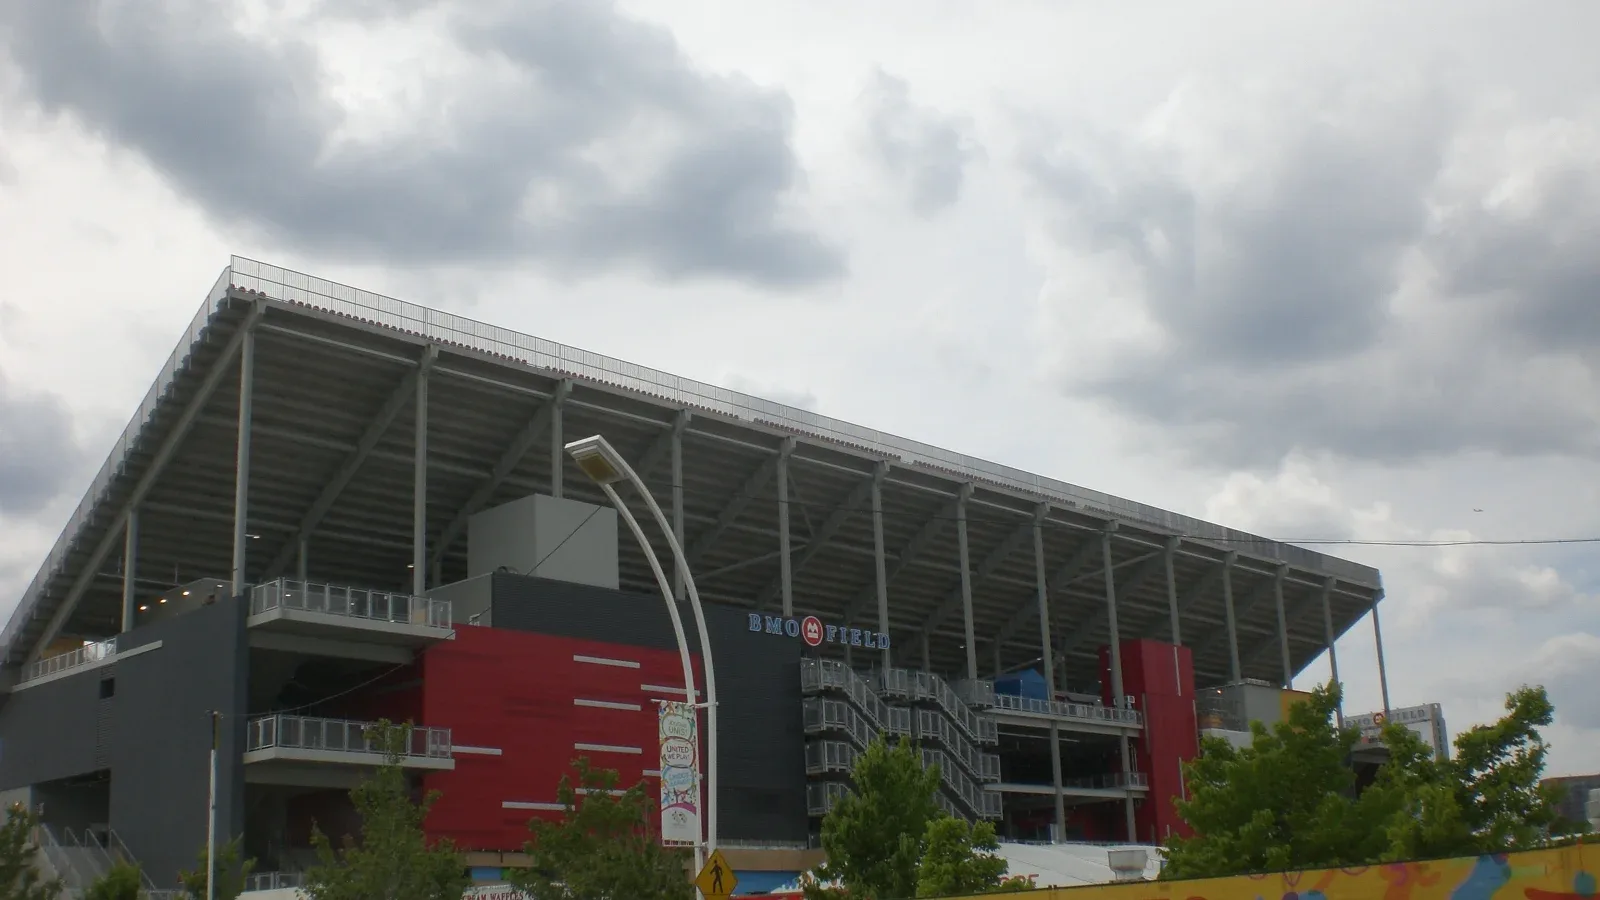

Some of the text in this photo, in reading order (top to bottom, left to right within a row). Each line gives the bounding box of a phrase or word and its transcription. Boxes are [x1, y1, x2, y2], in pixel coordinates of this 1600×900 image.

[748, 613, 891, 650] BMO FIELD
[667, 745, 690, 755] UNITED
